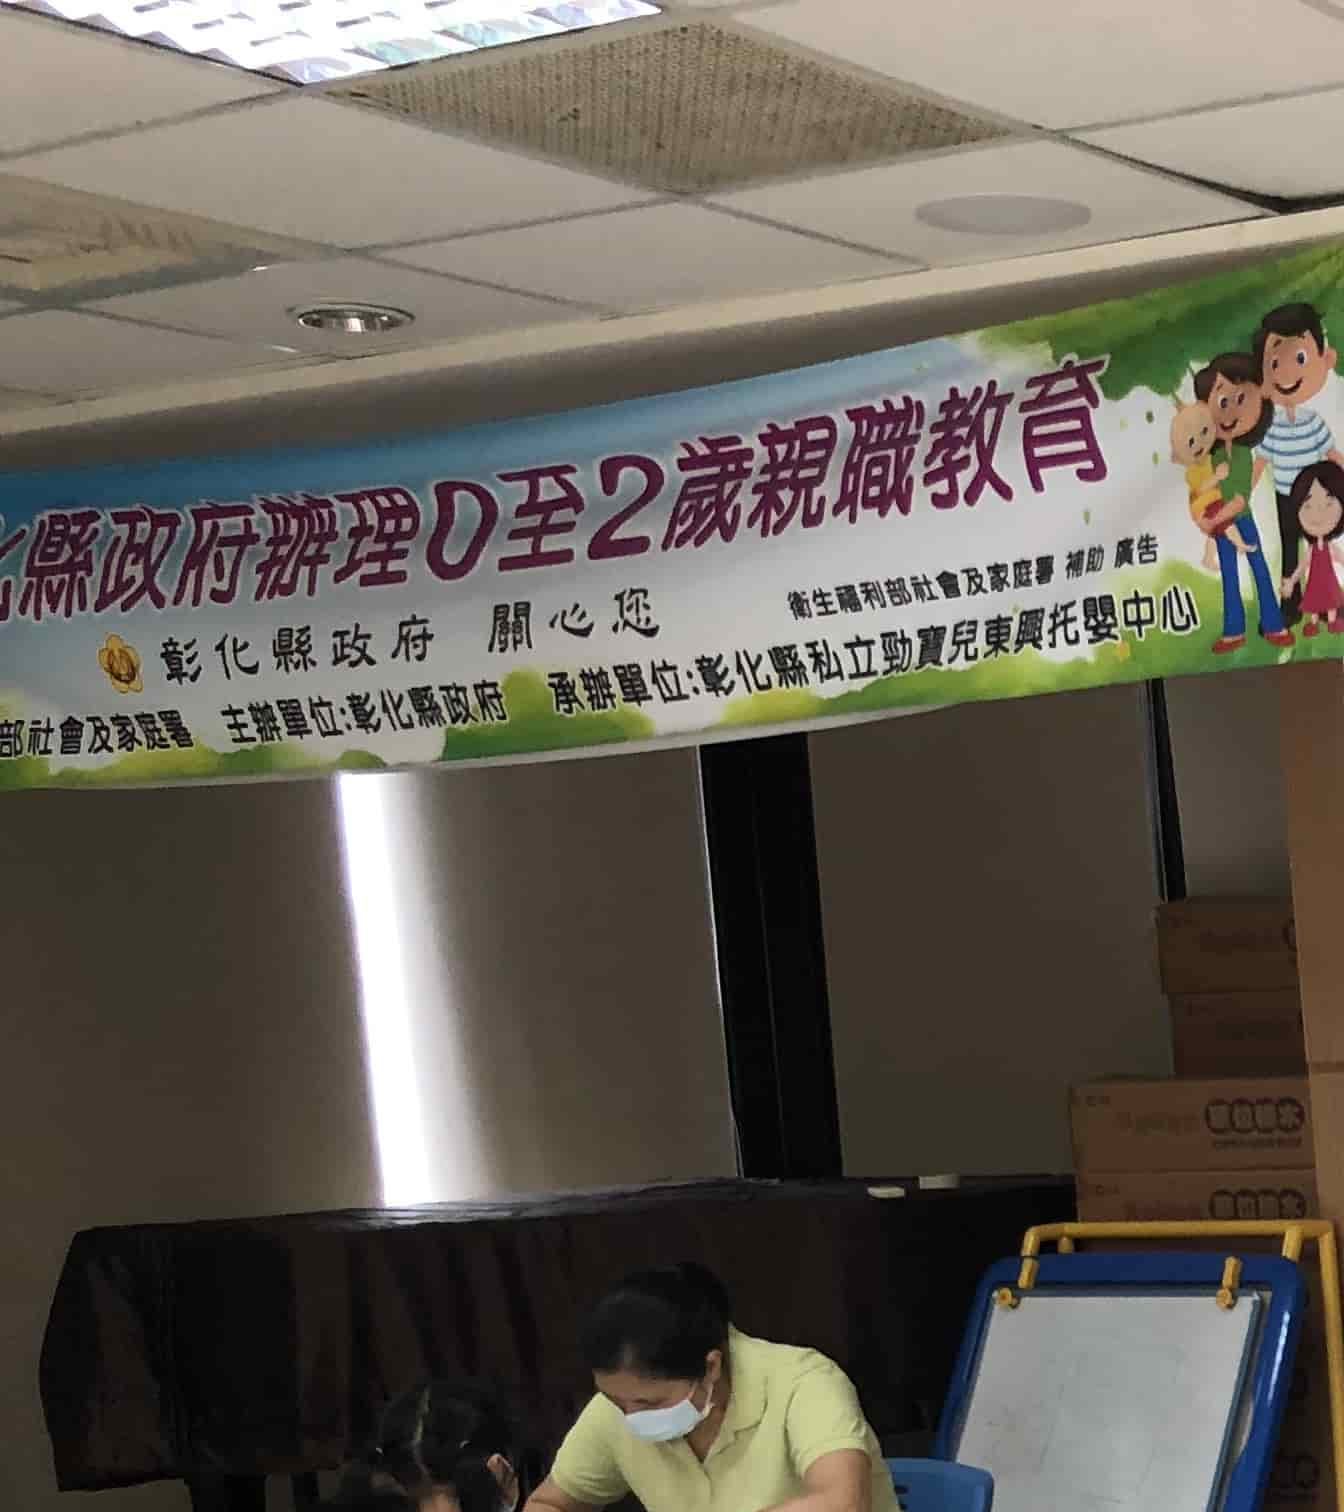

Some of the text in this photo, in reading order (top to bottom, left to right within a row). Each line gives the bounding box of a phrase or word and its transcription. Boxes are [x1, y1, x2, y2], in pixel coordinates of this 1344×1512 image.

[1065, 542, 1104, 579] 補助
[1113, 533, 1159, 568] 廣告
[160, 587, 661, 686] 彰化縣政府 關心您
